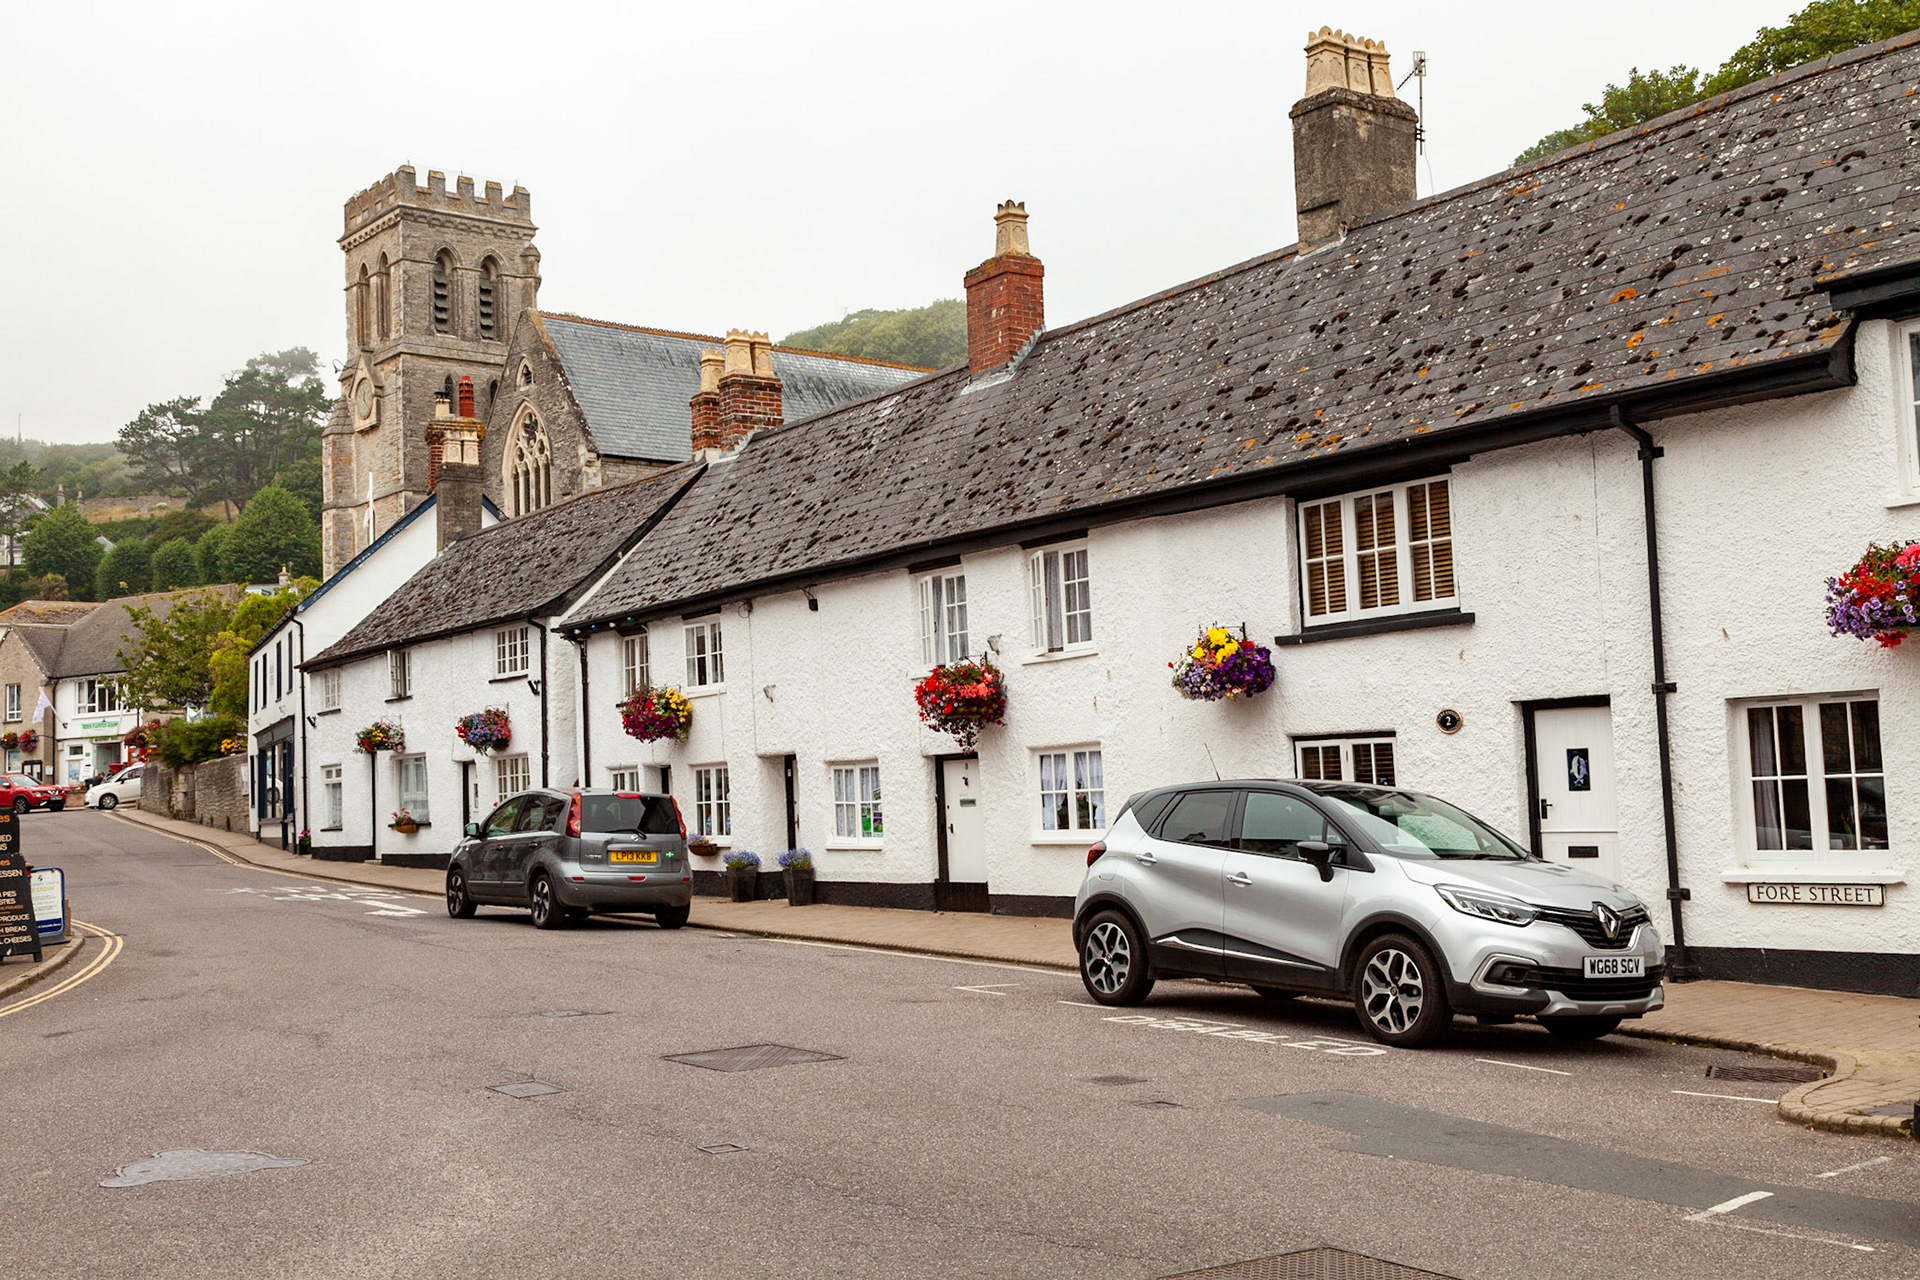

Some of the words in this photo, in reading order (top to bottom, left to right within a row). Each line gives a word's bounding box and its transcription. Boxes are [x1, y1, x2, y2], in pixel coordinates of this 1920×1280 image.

[1445, 716, 1452, 726] 2
[616, 851, 635, 861] LP13
[636, 851, 652, 861] KKB
[1756, 885, 1801, 901] FORE
[1808, 886, 1875, 903] STREET
[5, 925, 28, 933] BREAD
[1589, 959, 1618, 974] WG68
[1620, 958, 1640, 974] SGV
[1101, 1015, 1387, 1056] DISABLED
